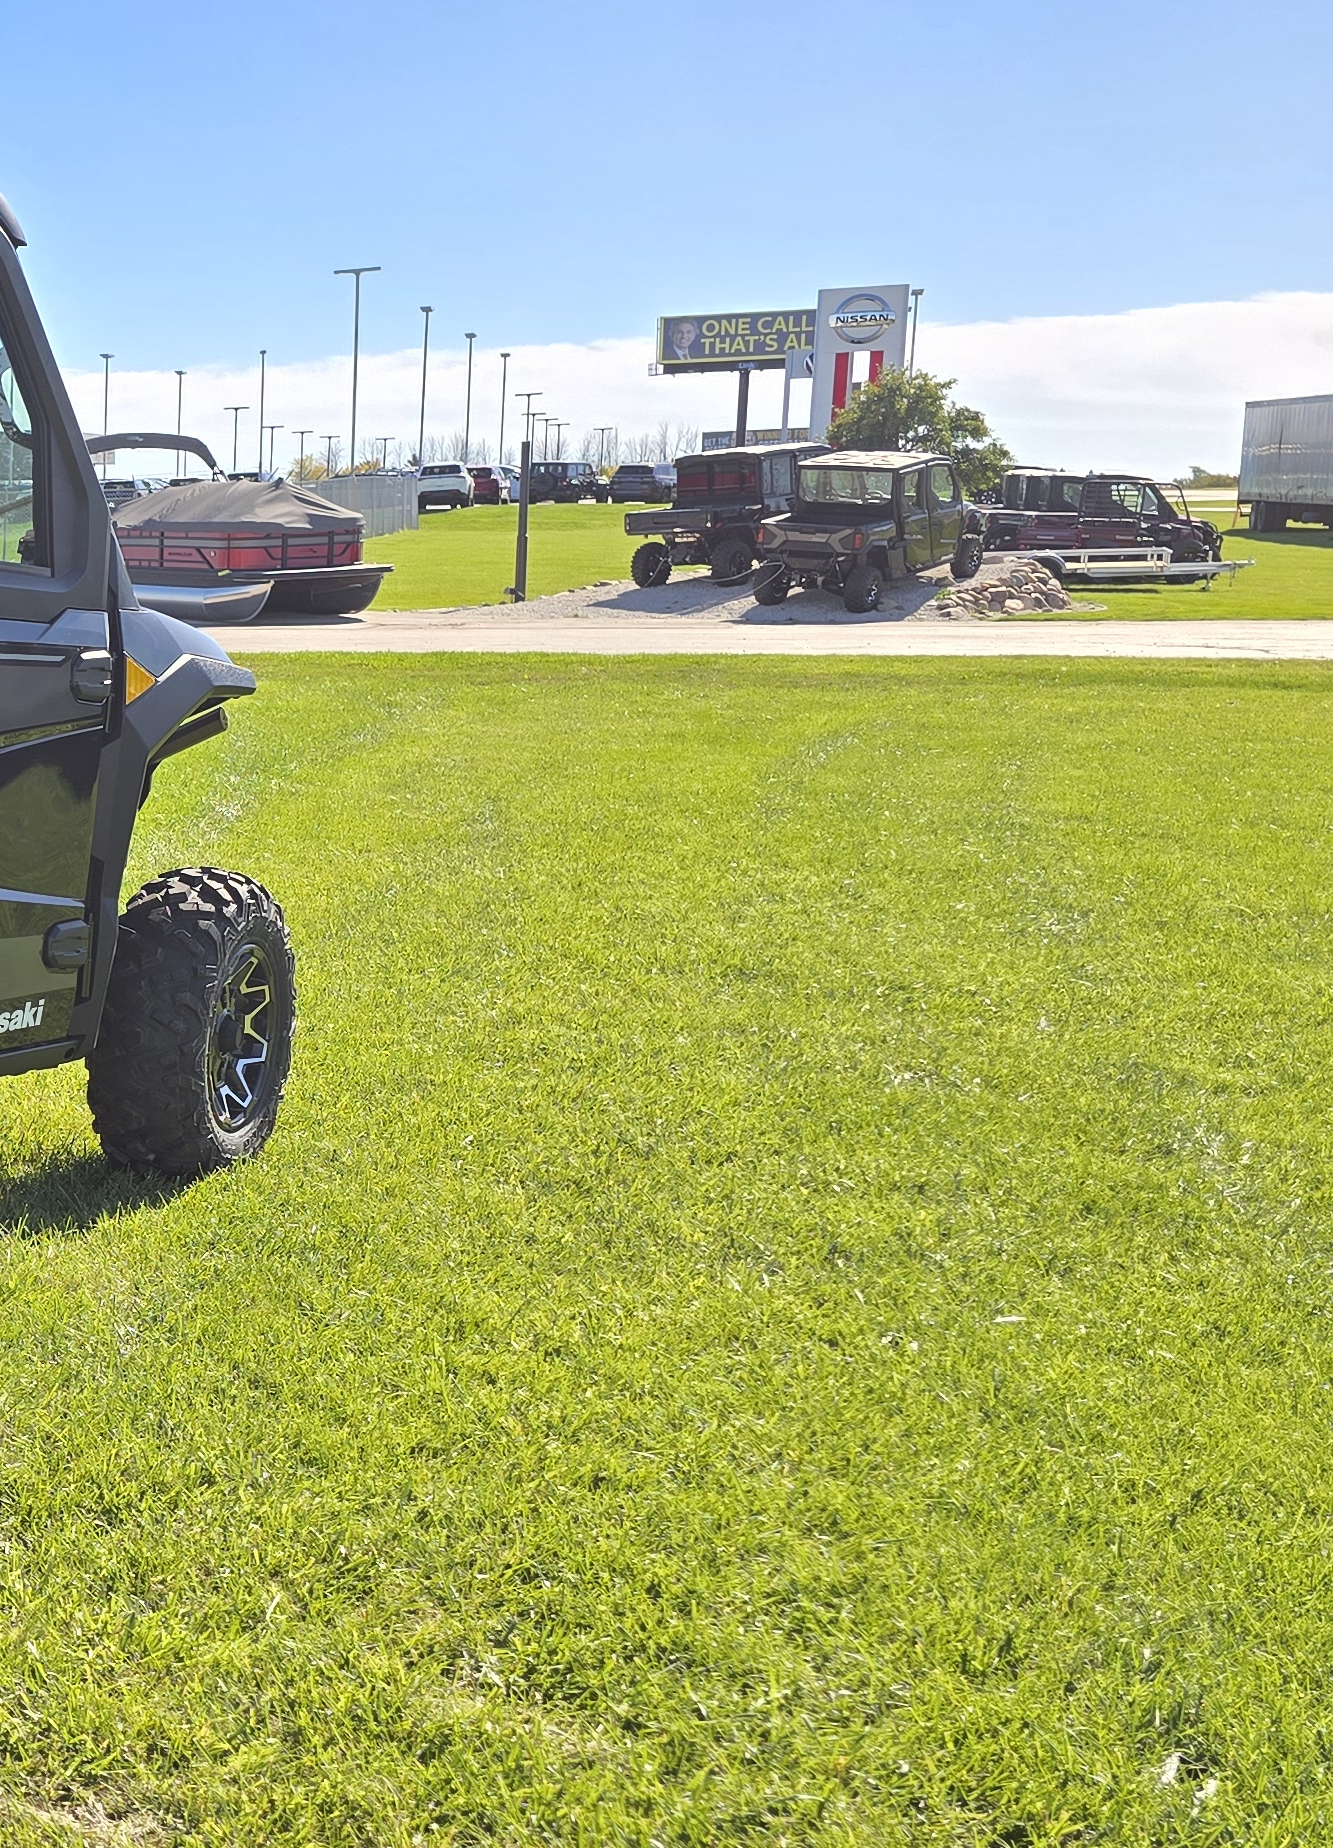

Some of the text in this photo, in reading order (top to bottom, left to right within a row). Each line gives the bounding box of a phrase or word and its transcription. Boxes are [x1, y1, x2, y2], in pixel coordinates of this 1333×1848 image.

[702, 318, 751, 336] ONE
[835, 313, 890, 325] NISSAN
[701, 333, 813, 355] THAT'S AL
